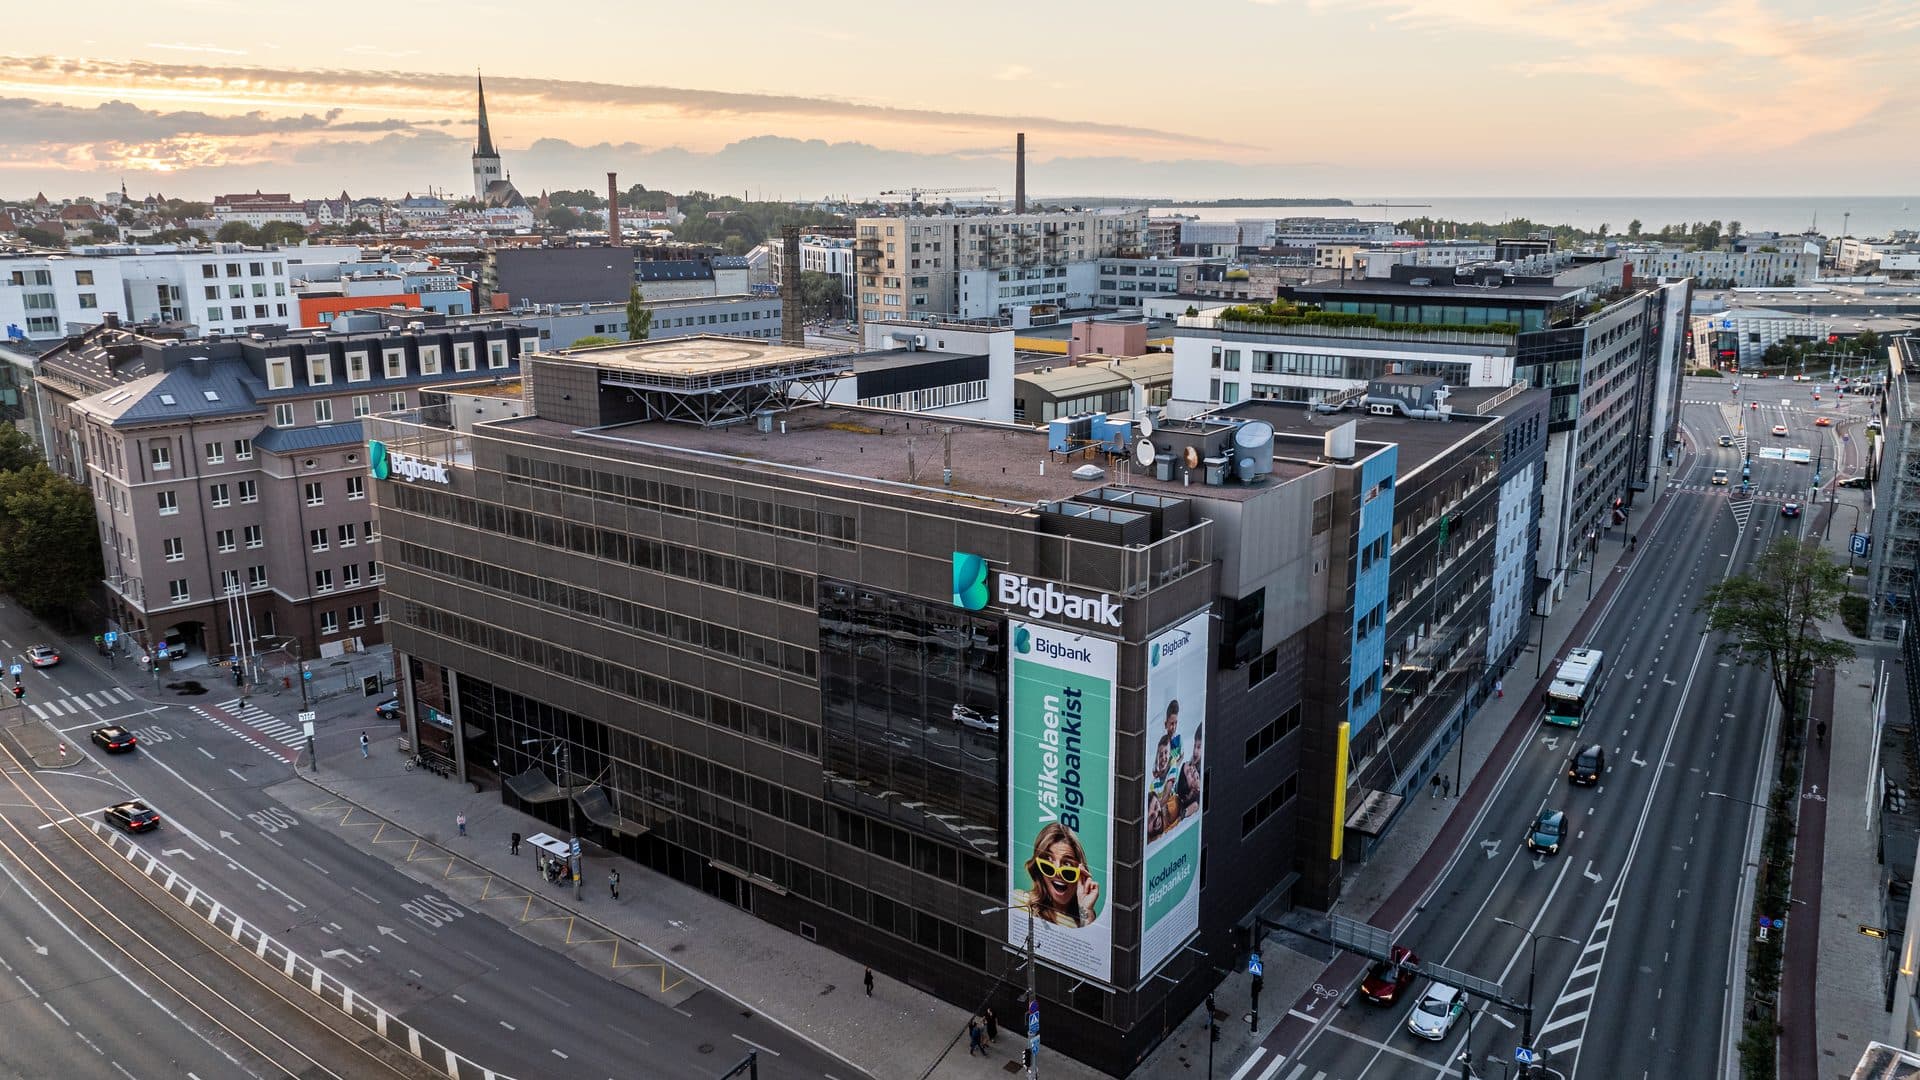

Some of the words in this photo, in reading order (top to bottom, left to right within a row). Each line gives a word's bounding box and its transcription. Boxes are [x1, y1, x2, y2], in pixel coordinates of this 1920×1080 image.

[391, 452, 449, 484] Bigbank
[998, 573, 1122, 627] Bigbank
[1036, 637, 1092, 663] Bigbank
[1162, 634, 1190, 657] Bigbank
[131, 725, 173, 746] BUS
[1038, 694, 1060, 823] Väikelaen
[1061, 686, 1084, 833] Bigbankist
[247, 806, 300, 834] BUS
[1147, 864, 1192, 907] Bigbankist
[1148, 852, 1188, 891] Kodulaen
[400, 894, 465, 928] BUS
